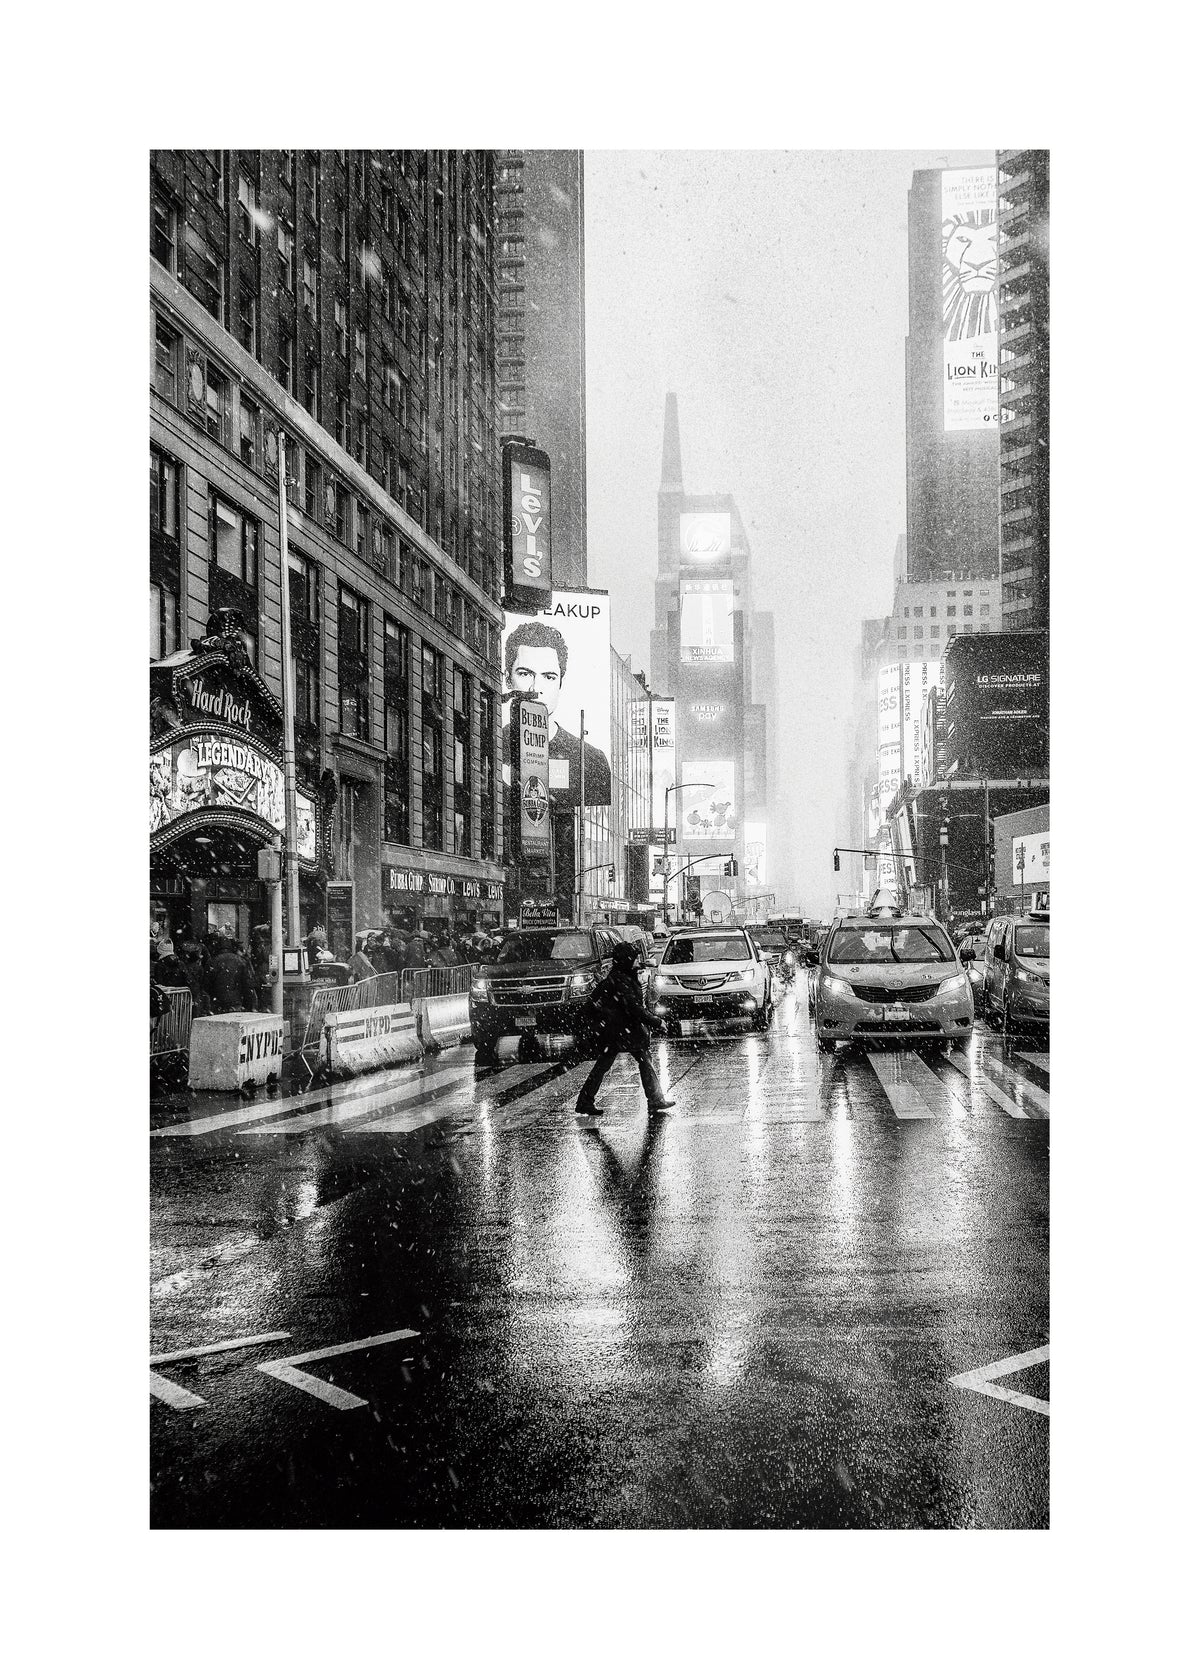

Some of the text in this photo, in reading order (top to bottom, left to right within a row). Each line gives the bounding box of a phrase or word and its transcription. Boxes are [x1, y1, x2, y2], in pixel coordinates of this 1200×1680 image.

[971, 350, 985, 358] THE
[977, 674, 1041, 683] LG SIGNATURE
[191, 679, 252, 733] Hard Rock
[690, 704, 725, 712] SAMSUNG
[521, 708, 548, 730] BUBBA
[656, 717, 670, 725] THE
[698, 712, 717, 722] pay
[523, 729, 546, 748] GUMP
[198, 741, 268, 782] LEGENDARY
[523, 759, 547, 767] COMPANY
[522, 908, 540, 918] Bella
[366, 1015, 391, 1039] NYPD
[246, 1029, 278, 1063] NYPD
